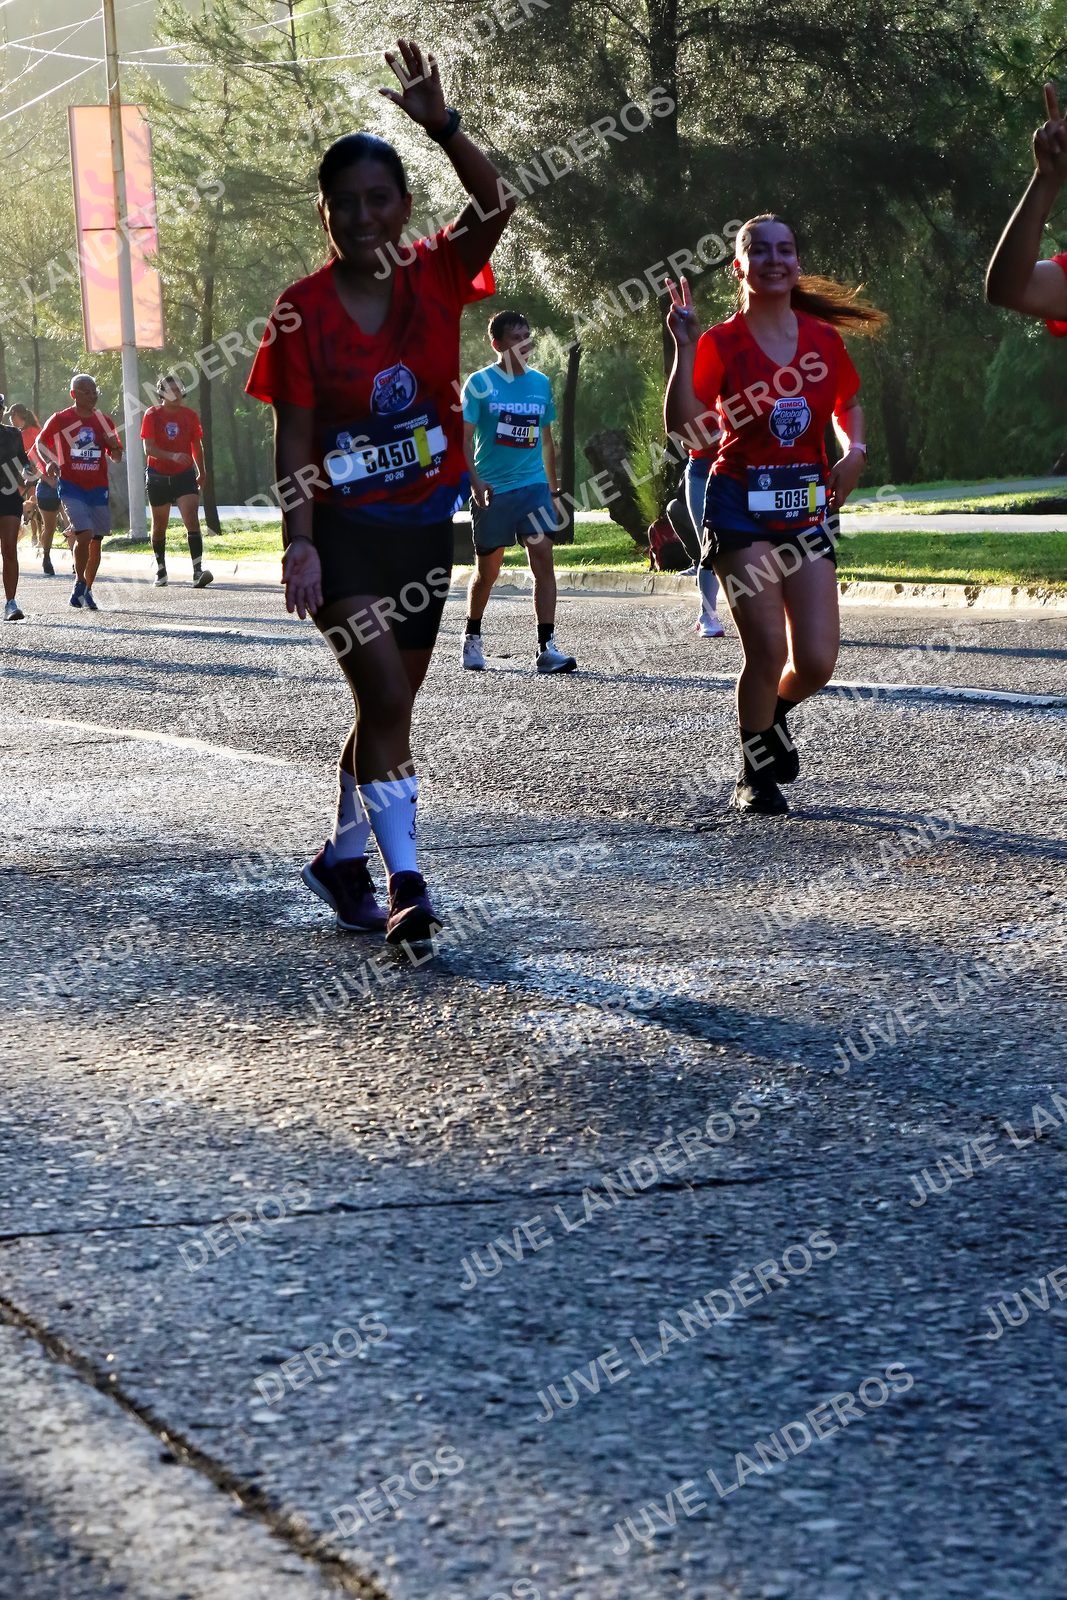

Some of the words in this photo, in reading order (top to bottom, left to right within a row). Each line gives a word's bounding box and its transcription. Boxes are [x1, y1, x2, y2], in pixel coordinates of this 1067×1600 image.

[780, 409, 803, 418] Global
[362, 440, 417, 474] 5450
[384, 469, 405, 482] 20-26
[425, 467, 440, 479] 10K
[775, 489, 808, 509] 5035
